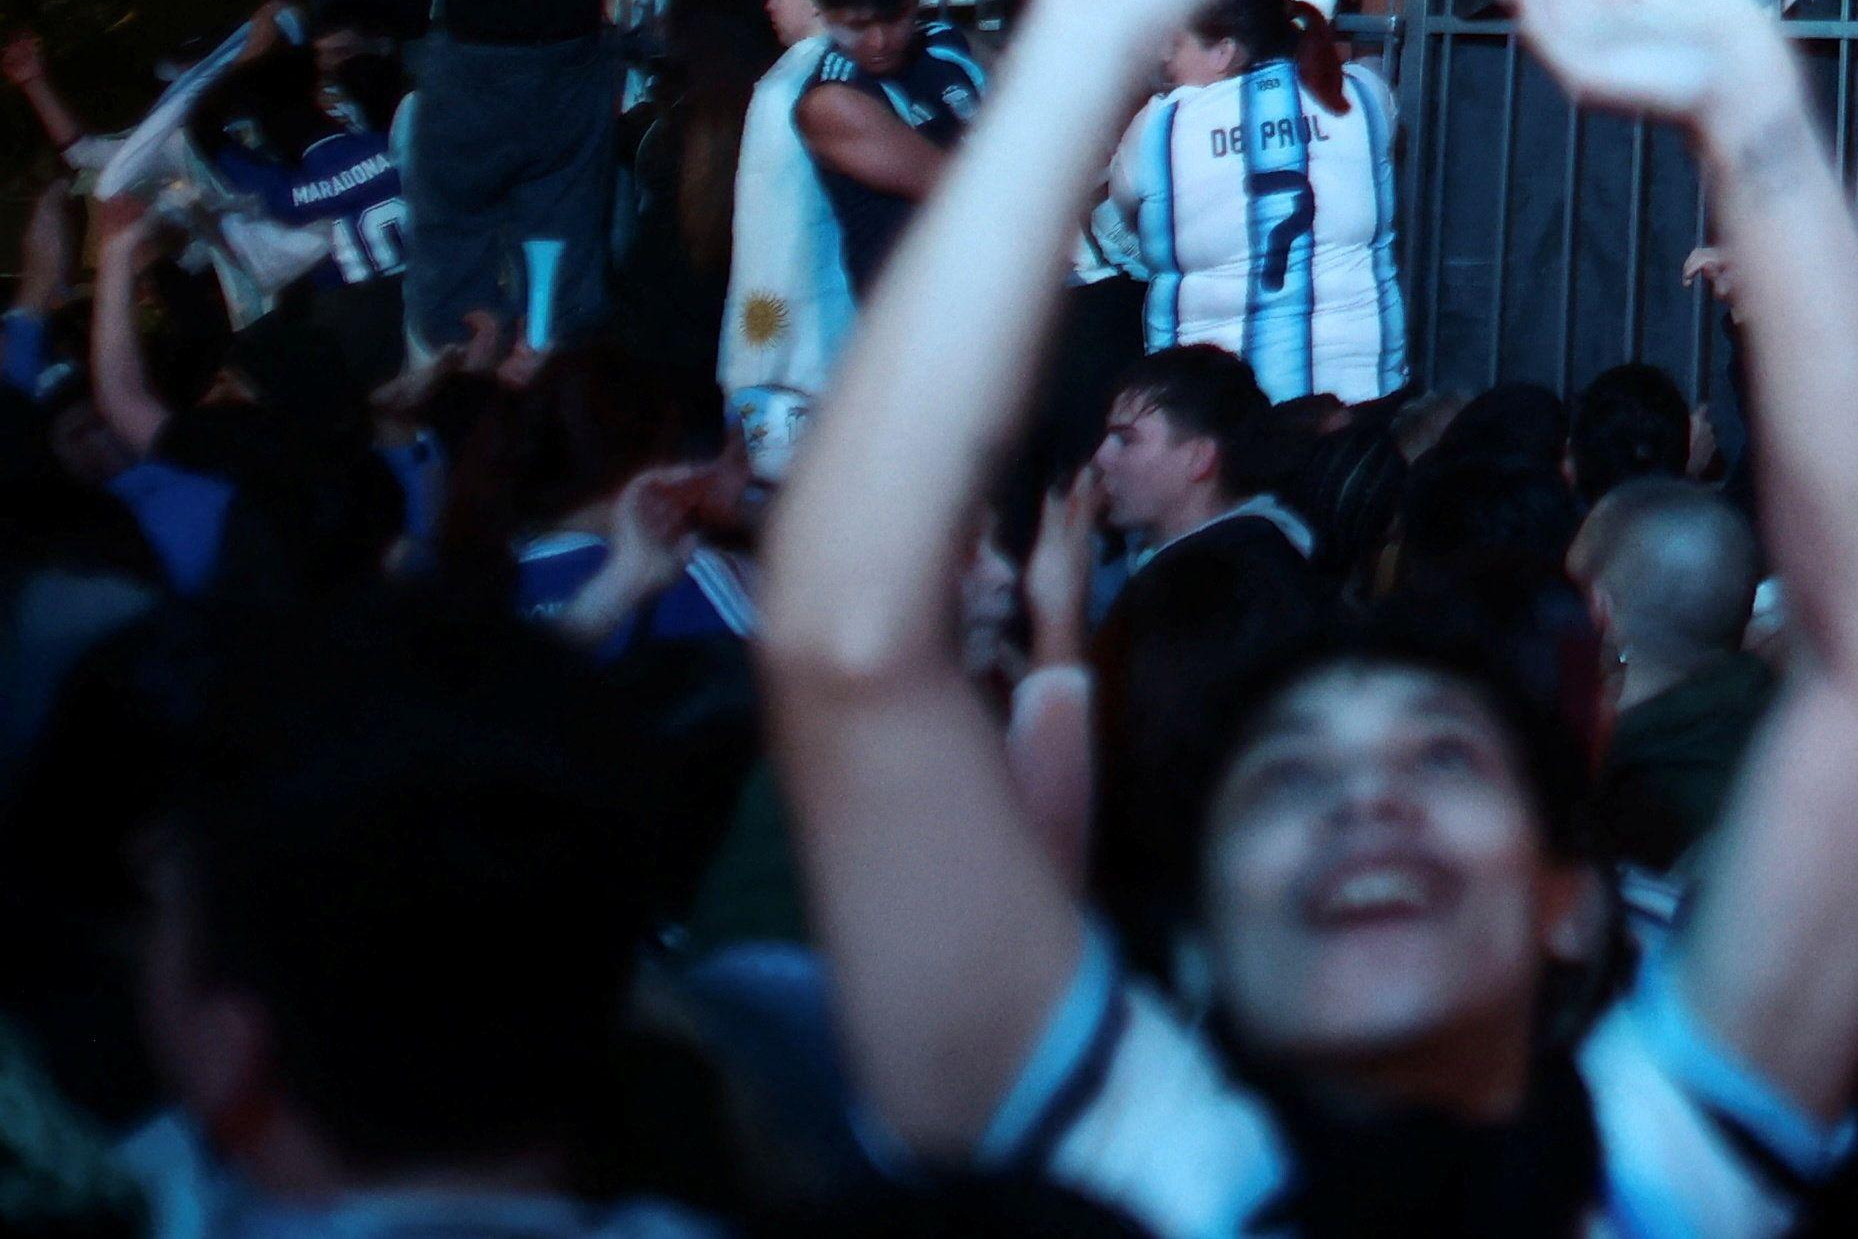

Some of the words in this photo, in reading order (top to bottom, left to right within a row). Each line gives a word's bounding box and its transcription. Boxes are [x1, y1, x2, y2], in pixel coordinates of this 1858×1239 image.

[1211, 126, 1245, 158] DE
[1260, 114, 1330, 150] PAUL
[291, 153, 390, 207] MARADONA
[331, 197, 408, 284] 10
[1245, 169, 1316, 293] 7
